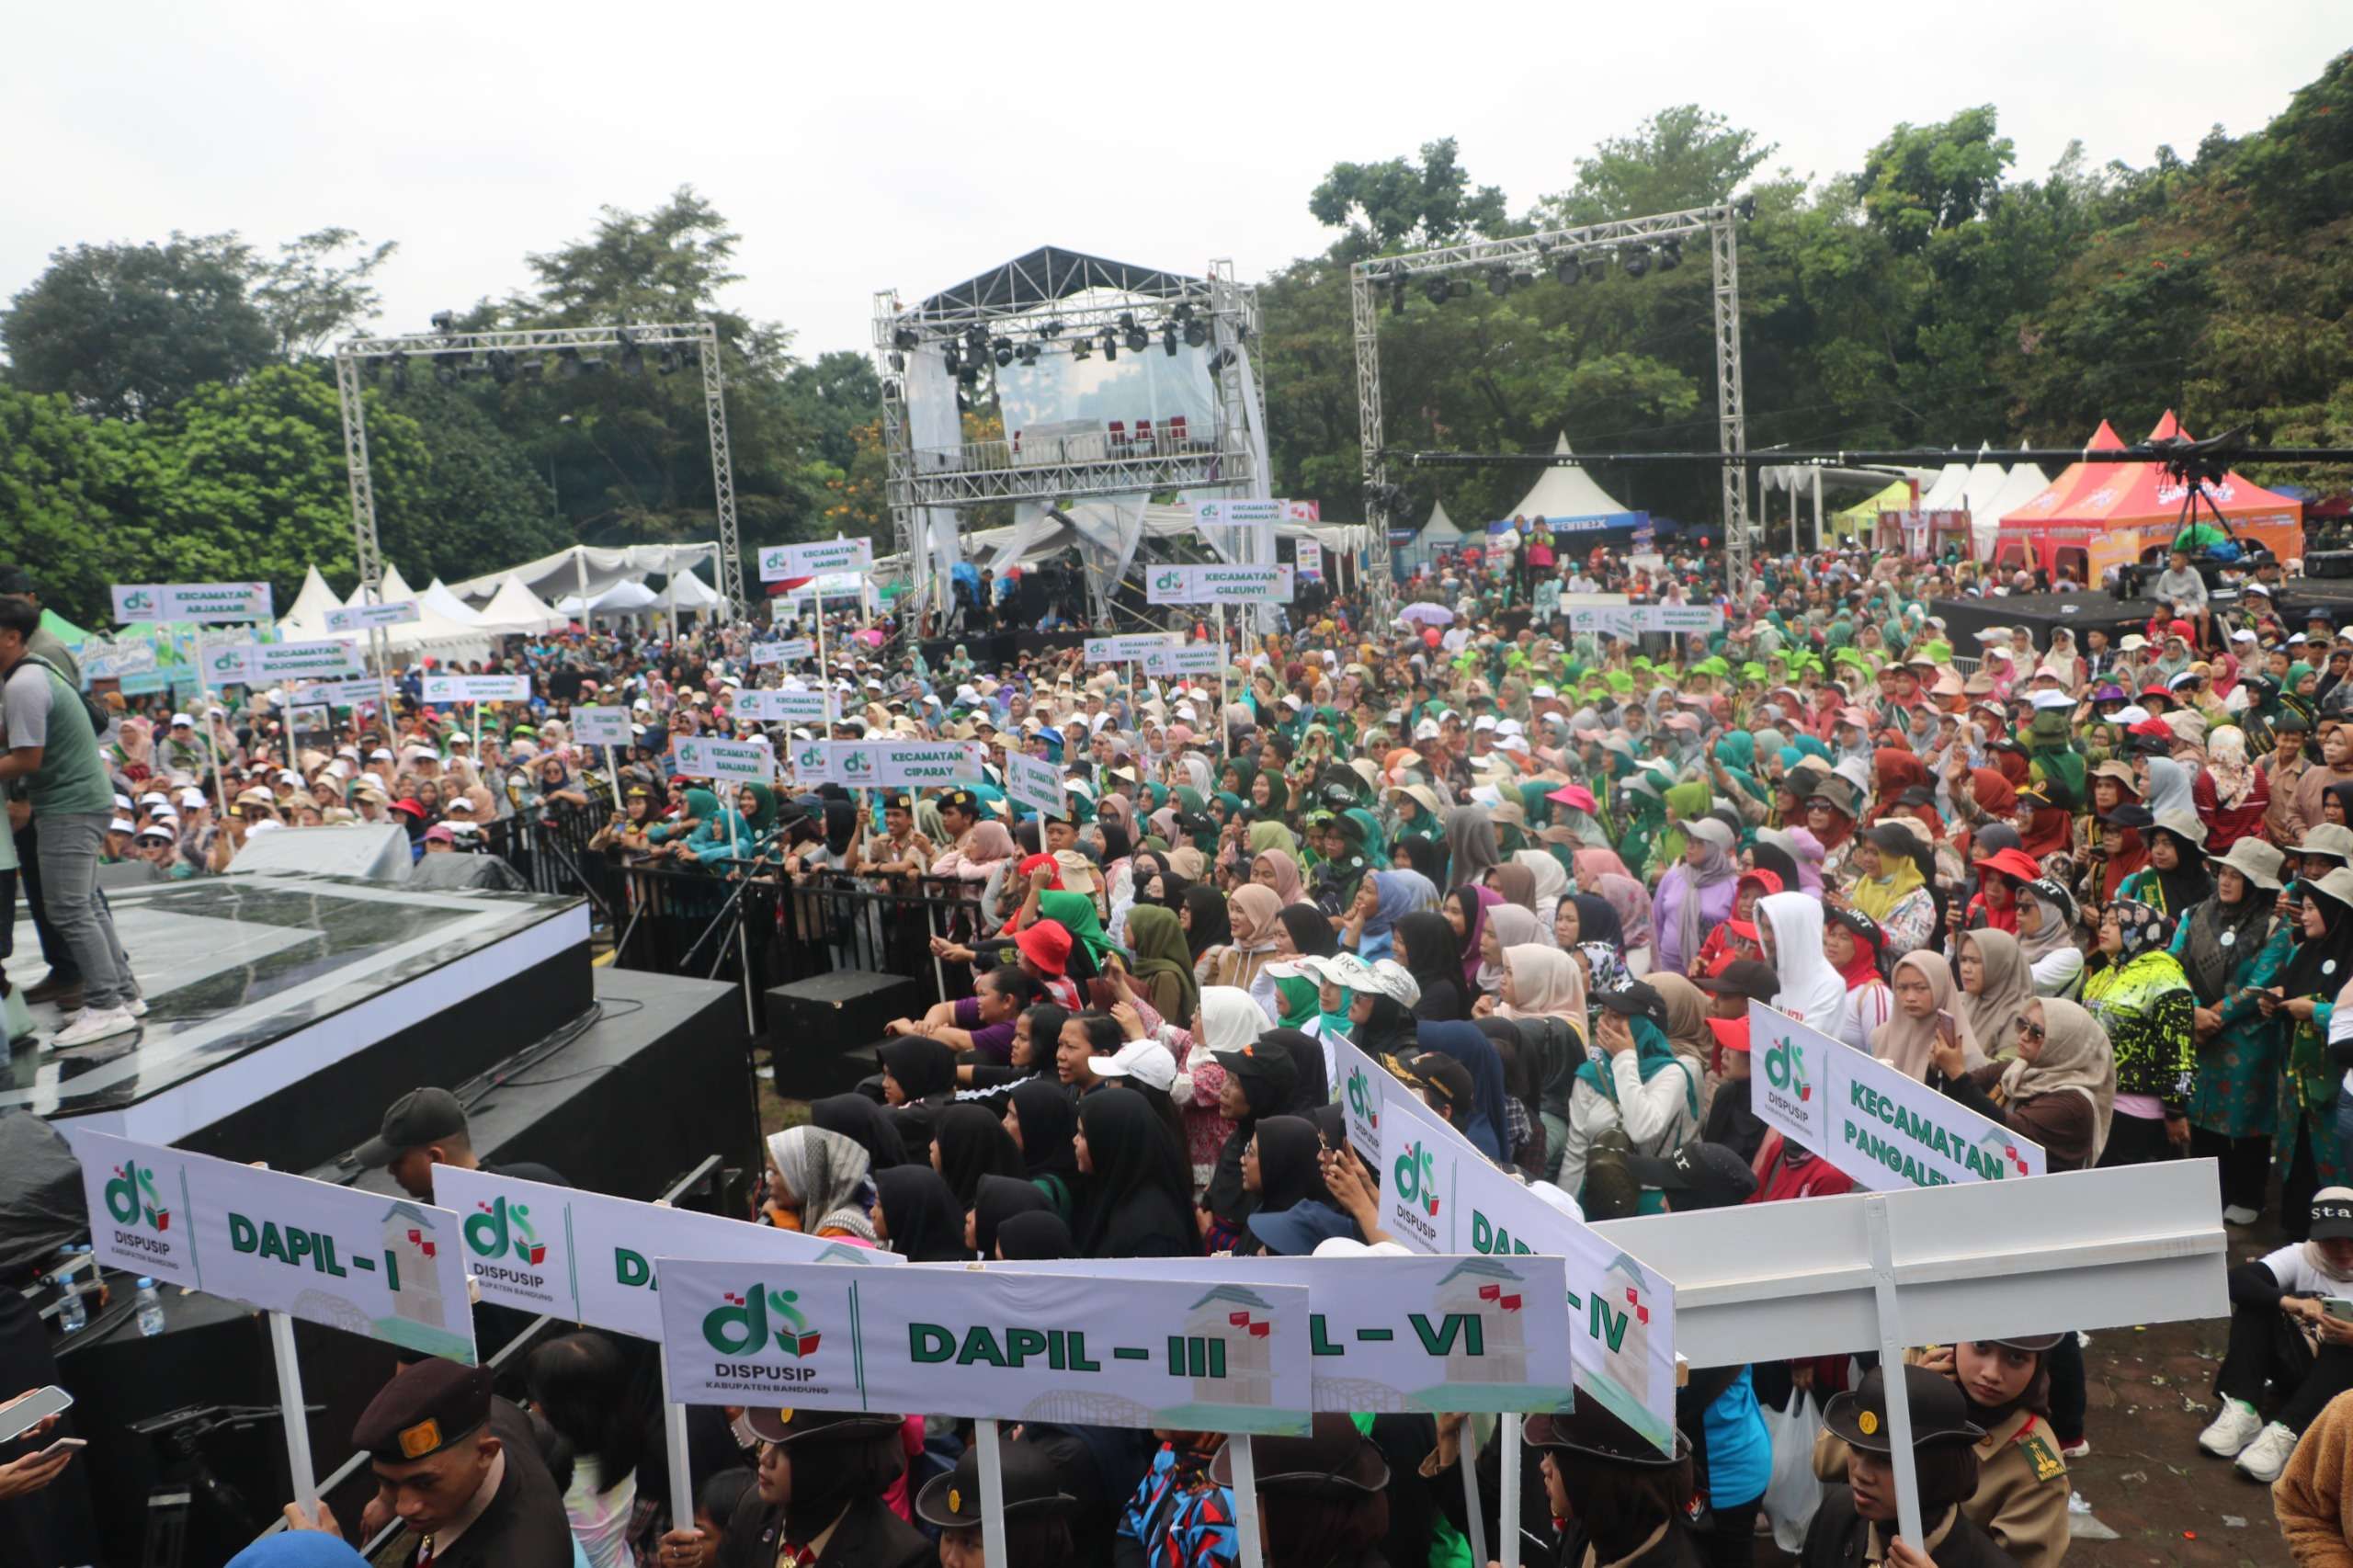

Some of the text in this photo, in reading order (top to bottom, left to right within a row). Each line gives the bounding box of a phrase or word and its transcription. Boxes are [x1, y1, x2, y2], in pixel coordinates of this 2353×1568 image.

[802, 546, 858, 559] KECAMATAN
[1205, 573, 1277, 582] KECAMATAN
[176, 591, 253, 600] KECAMATAN
[1216, 586, 1266, 595] CILEUNYI
[266, 647, 341, 658] KECAMATAN
[711, 747, 761, 759] KECAMATAN
[891, 751, 963, 762] KECAMATAN
[904, 767, 954, 777] CIPARAY
[1768, 1092, 1809, 1122] DISPUSIP
[1850, 1079, 2005, 1181] KECAMATAN
[1397, 1204, 1437, 1241] DISPUSIP
[114, 1231, 170, 1256] DISPUSIP
[228, 1212, 347, 1278] DAPIL
[472, 1263, 544, 1289] DISPUSIP
[514, 1289, 553, 1302] BANDUNG
[1589, 1291, 1628, 1354] IV
[1407, 1314, 1484, 1356] VI
[909, 1323, 1100, 1372] DAPIL
[1167, 1335, 1226, 1379] III
[715, 1363, 816, 1382] DISPUSIP
[706, 1381, 829, 1395] KABUPATEN BANDUNG
